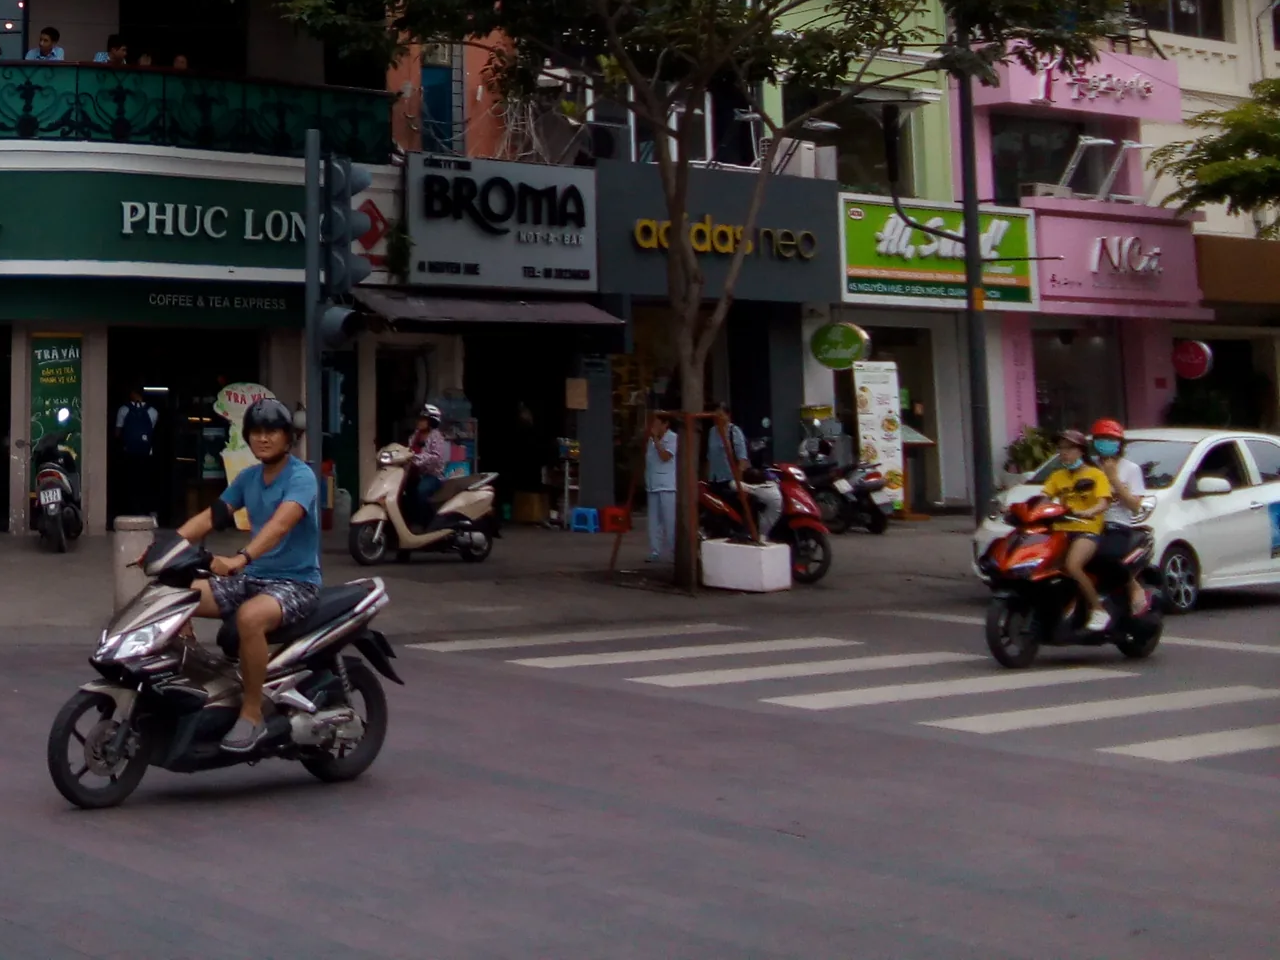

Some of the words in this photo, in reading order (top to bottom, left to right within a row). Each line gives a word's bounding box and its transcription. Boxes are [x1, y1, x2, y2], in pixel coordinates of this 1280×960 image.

[121, 200, 230, 240] PHUC
[242, 207, 326, 243] LON
[423, 174, 587, 236] BROMA
[634, 214, 755, 256] adas
[760, 227, 817, 260] neo
[148, 292, 194, 308] COFFEE
[208, 295, 231, 309] TEA
[233, 296, 288, 311] EXPRESS
